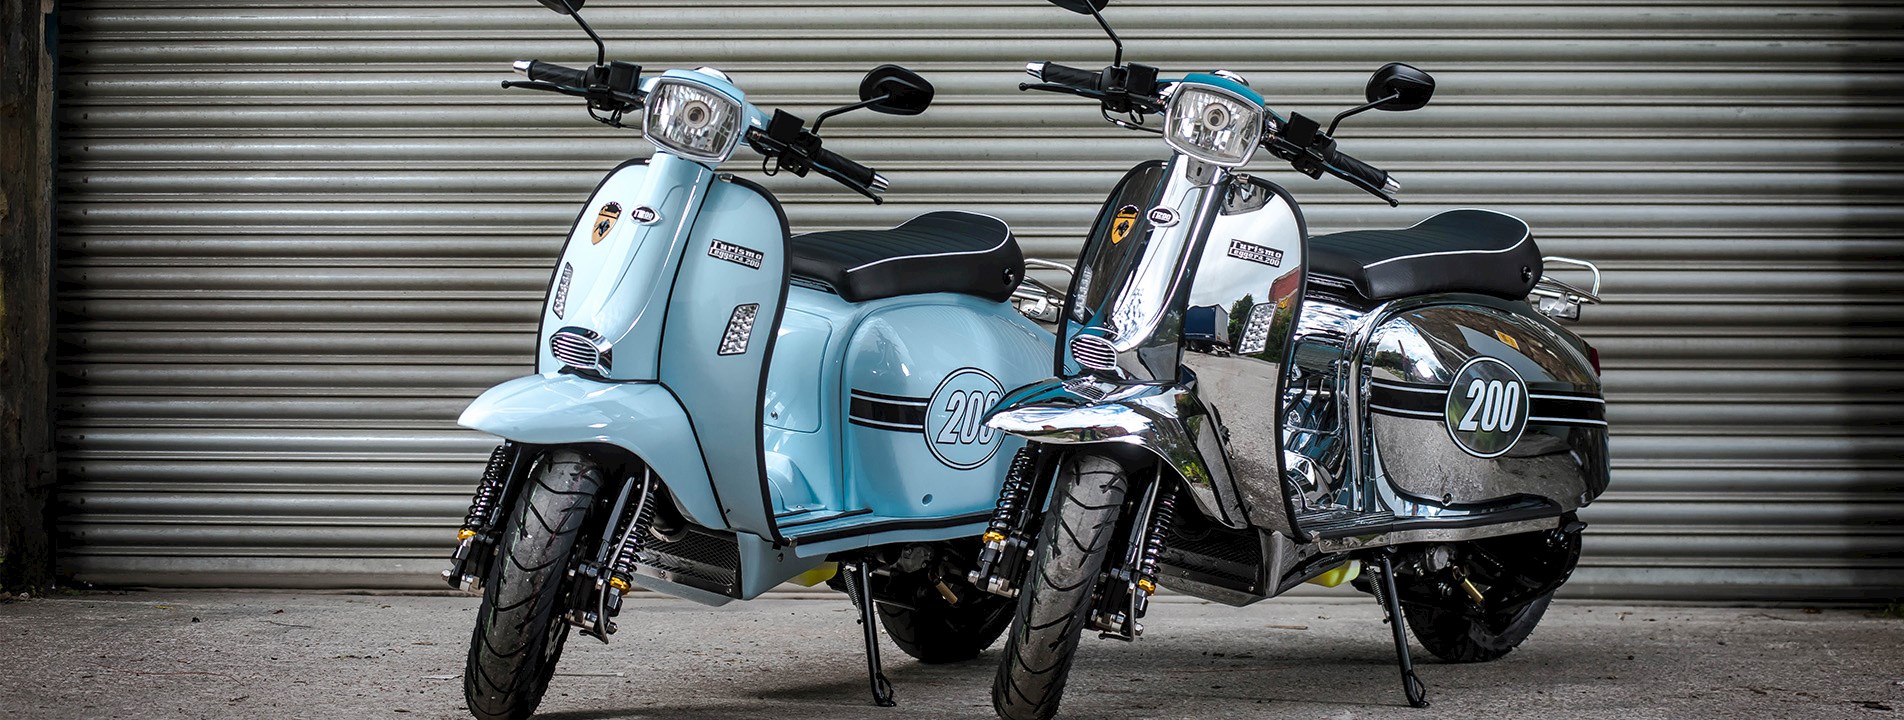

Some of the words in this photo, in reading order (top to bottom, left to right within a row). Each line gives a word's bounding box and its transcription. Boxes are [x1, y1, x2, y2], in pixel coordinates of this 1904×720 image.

[709, 247, 744, 262] Leggera
[744, 258, 760, 268] 200
[711, 240, 763, 260] Turismo
[1228, 247, 1264, 261] Leggera
[1264, 257, 1280, 267] 200
[1232, 240, 1282, 259] Turismo
[1457, 377, 1521, 432] 200
